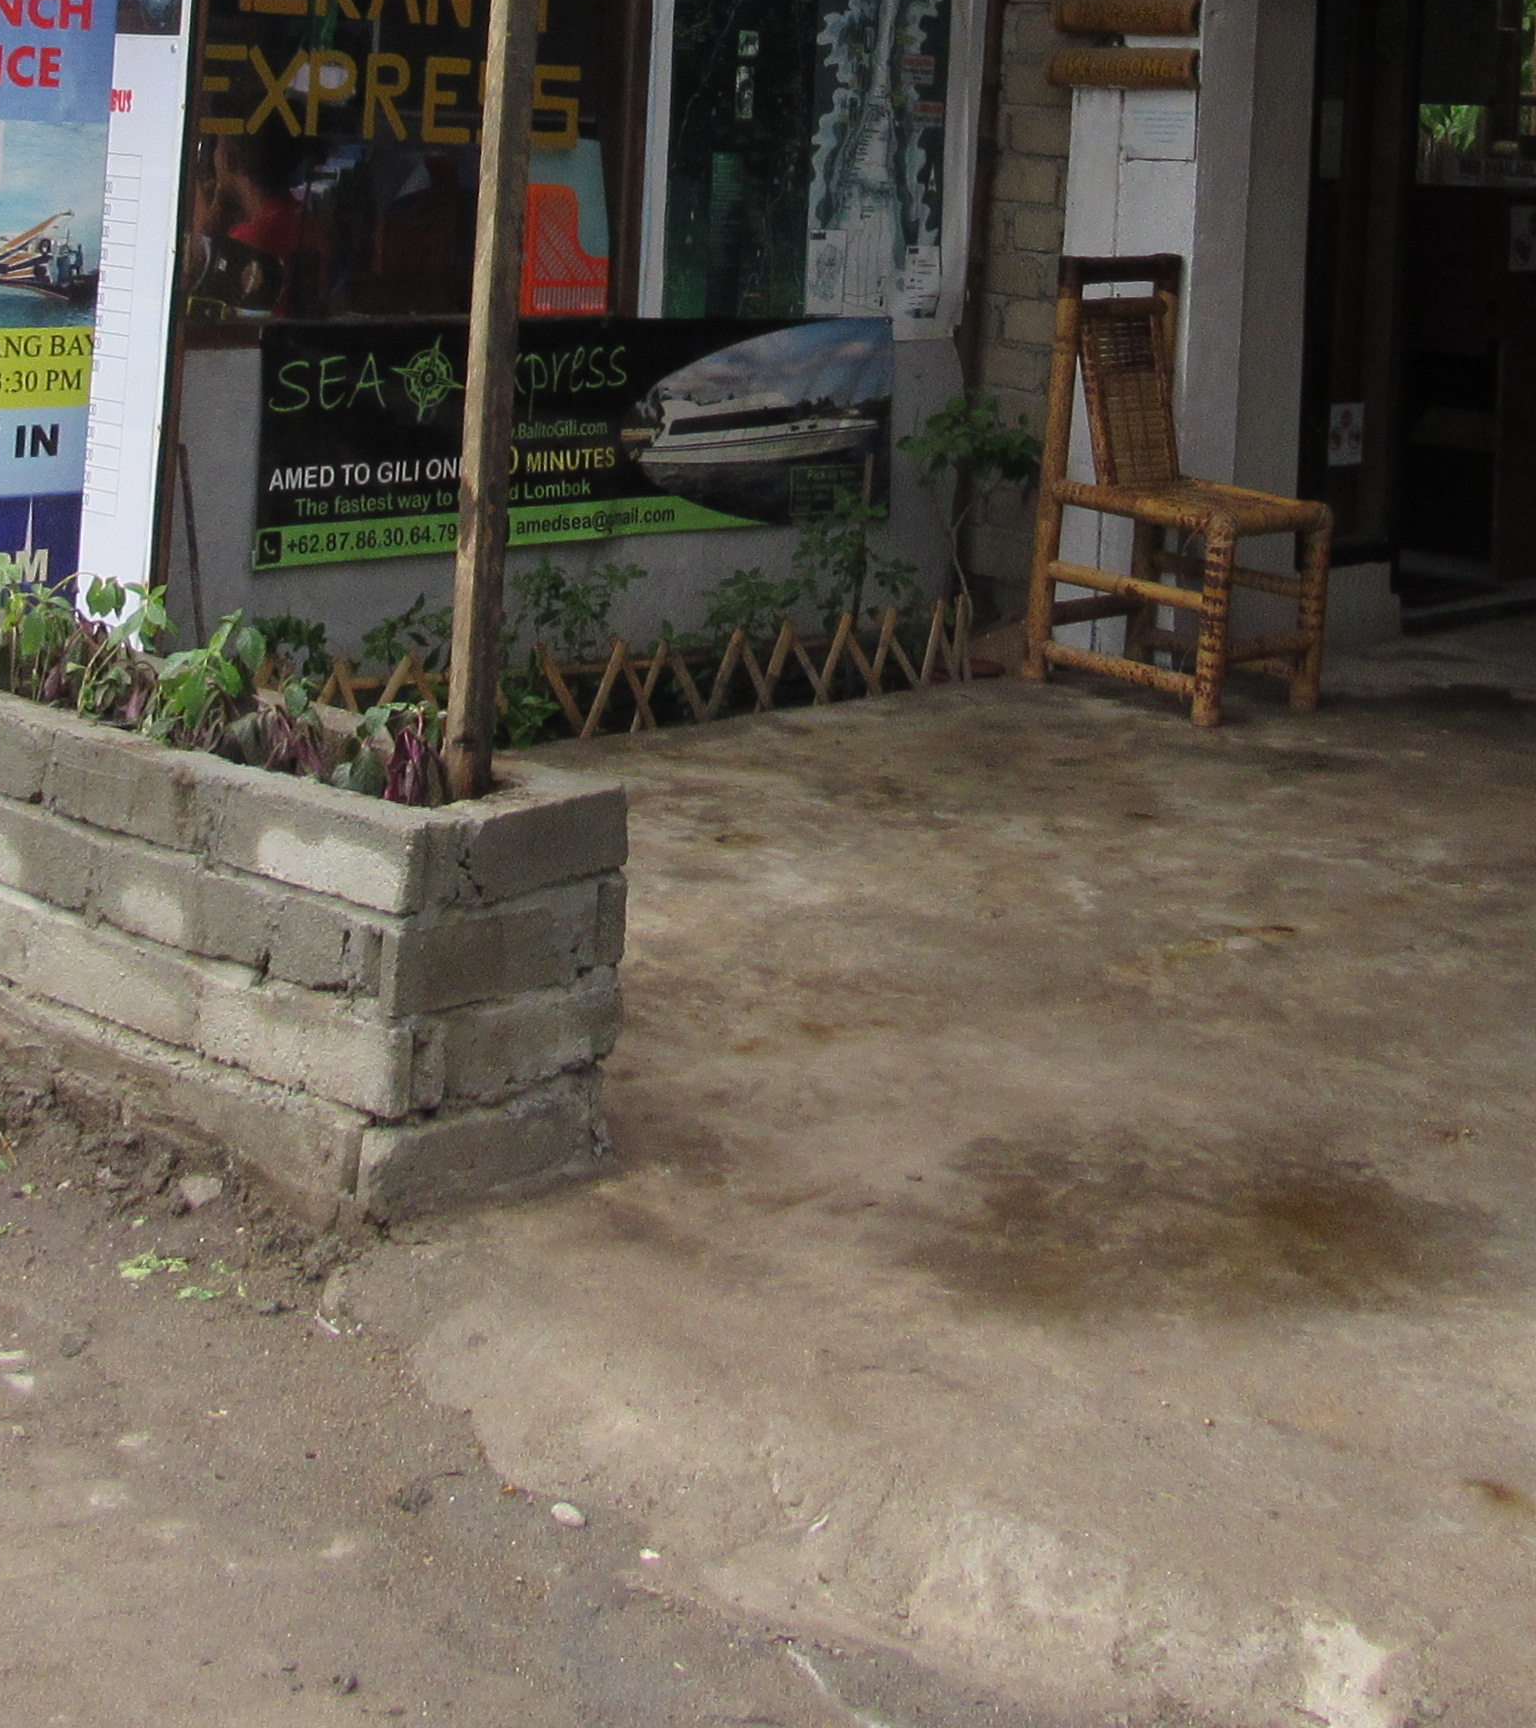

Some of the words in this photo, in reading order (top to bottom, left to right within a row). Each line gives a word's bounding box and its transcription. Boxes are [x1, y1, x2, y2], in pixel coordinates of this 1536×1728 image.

[199, 44, 581, 149] EXPRES
[46, 367, 83, 392] PM
[269, 352, 386, 413] SEA
[514, 346, 628, 421] press
[13, 422, 59, 459] IN
[512, 420, 608, 440] .BalitoGili.com
[269, 465, 334, 492] AMED
[341, 462, 371, 485] TO
[377, 458, 420, 484] GILI
[526, 446, 616, 473] MINUTES
[295, 496, 329, 517] The
[334, 491, 394, 514] fastest
[398, 492, 431, 513] way
[436, 489, 453, 507] to
[524, 478, 591, 499] Lombok
